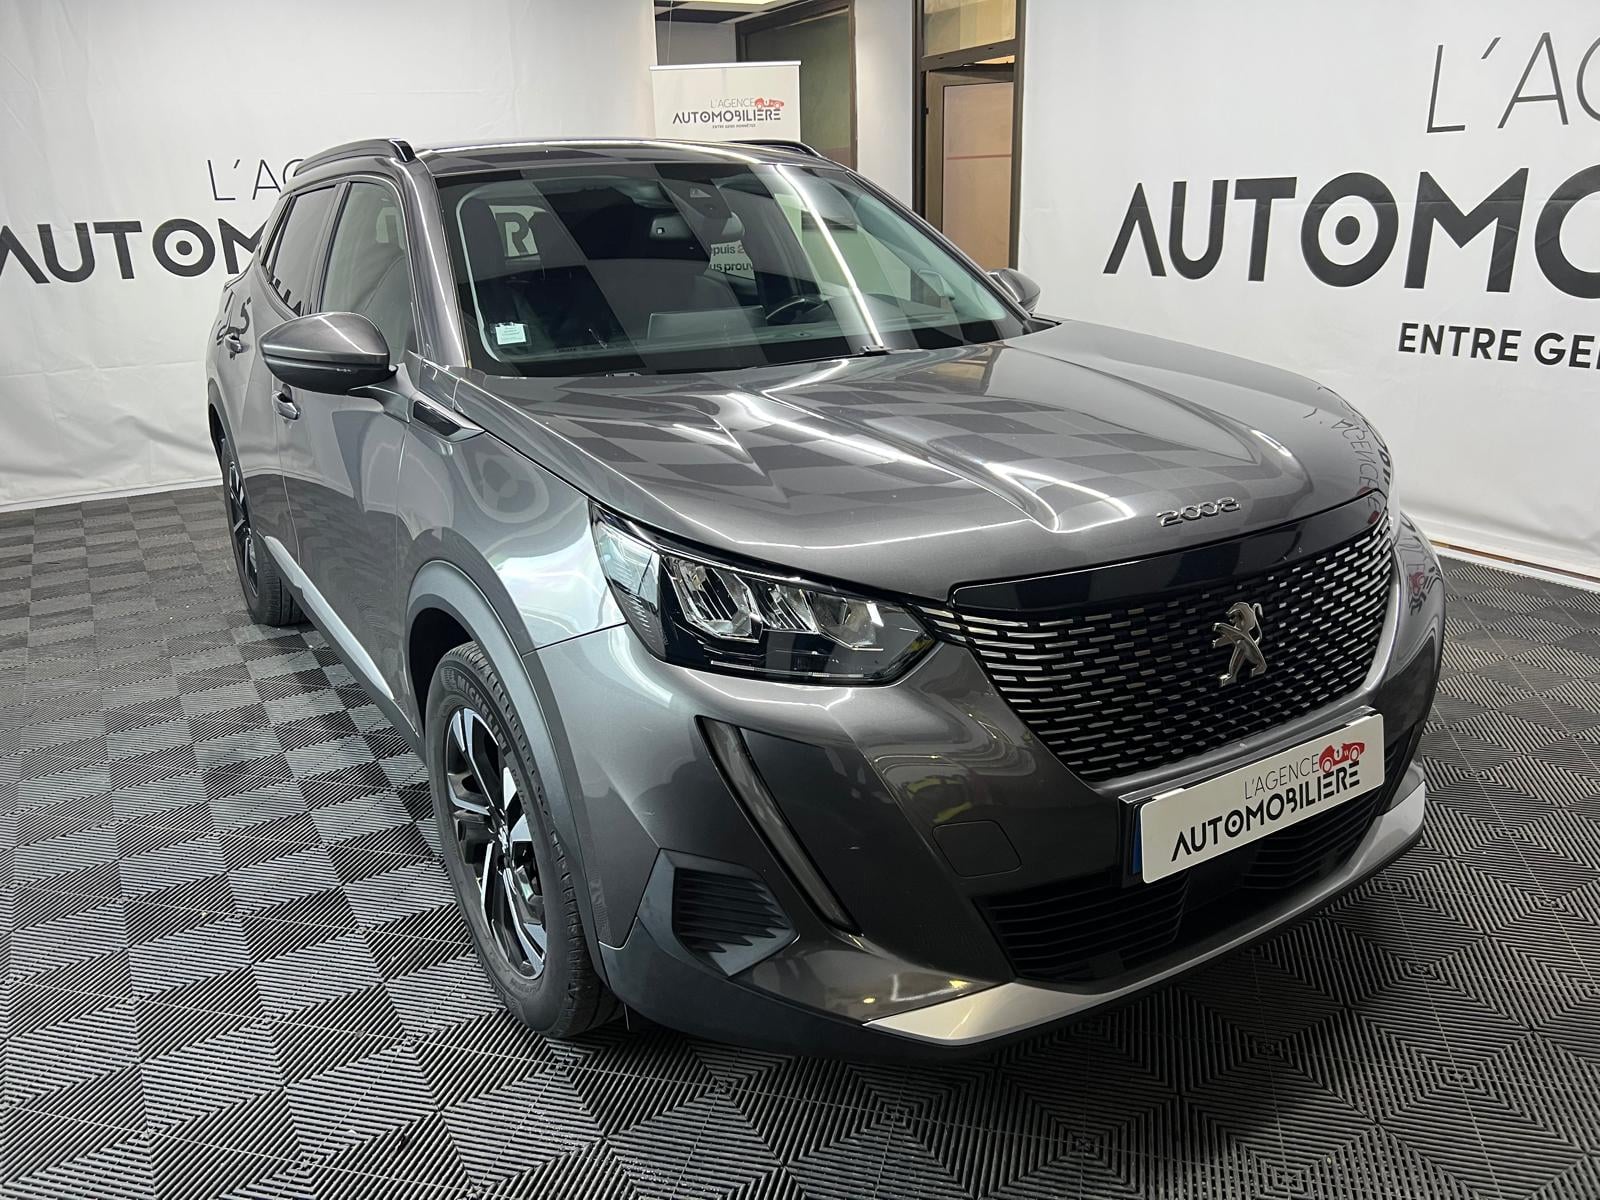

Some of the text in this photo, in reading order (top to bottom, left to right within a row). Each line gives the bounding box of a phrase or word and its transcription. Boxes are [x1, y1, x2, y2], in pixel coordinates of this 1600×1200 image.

[1398, 322, 1600, 370] ENTRE GE
[1156, 497, 1241, 527] 2008
[457, 674, 512, 758] MICHELIN
[1244, 753, 1320, 800] L'AGENCE
